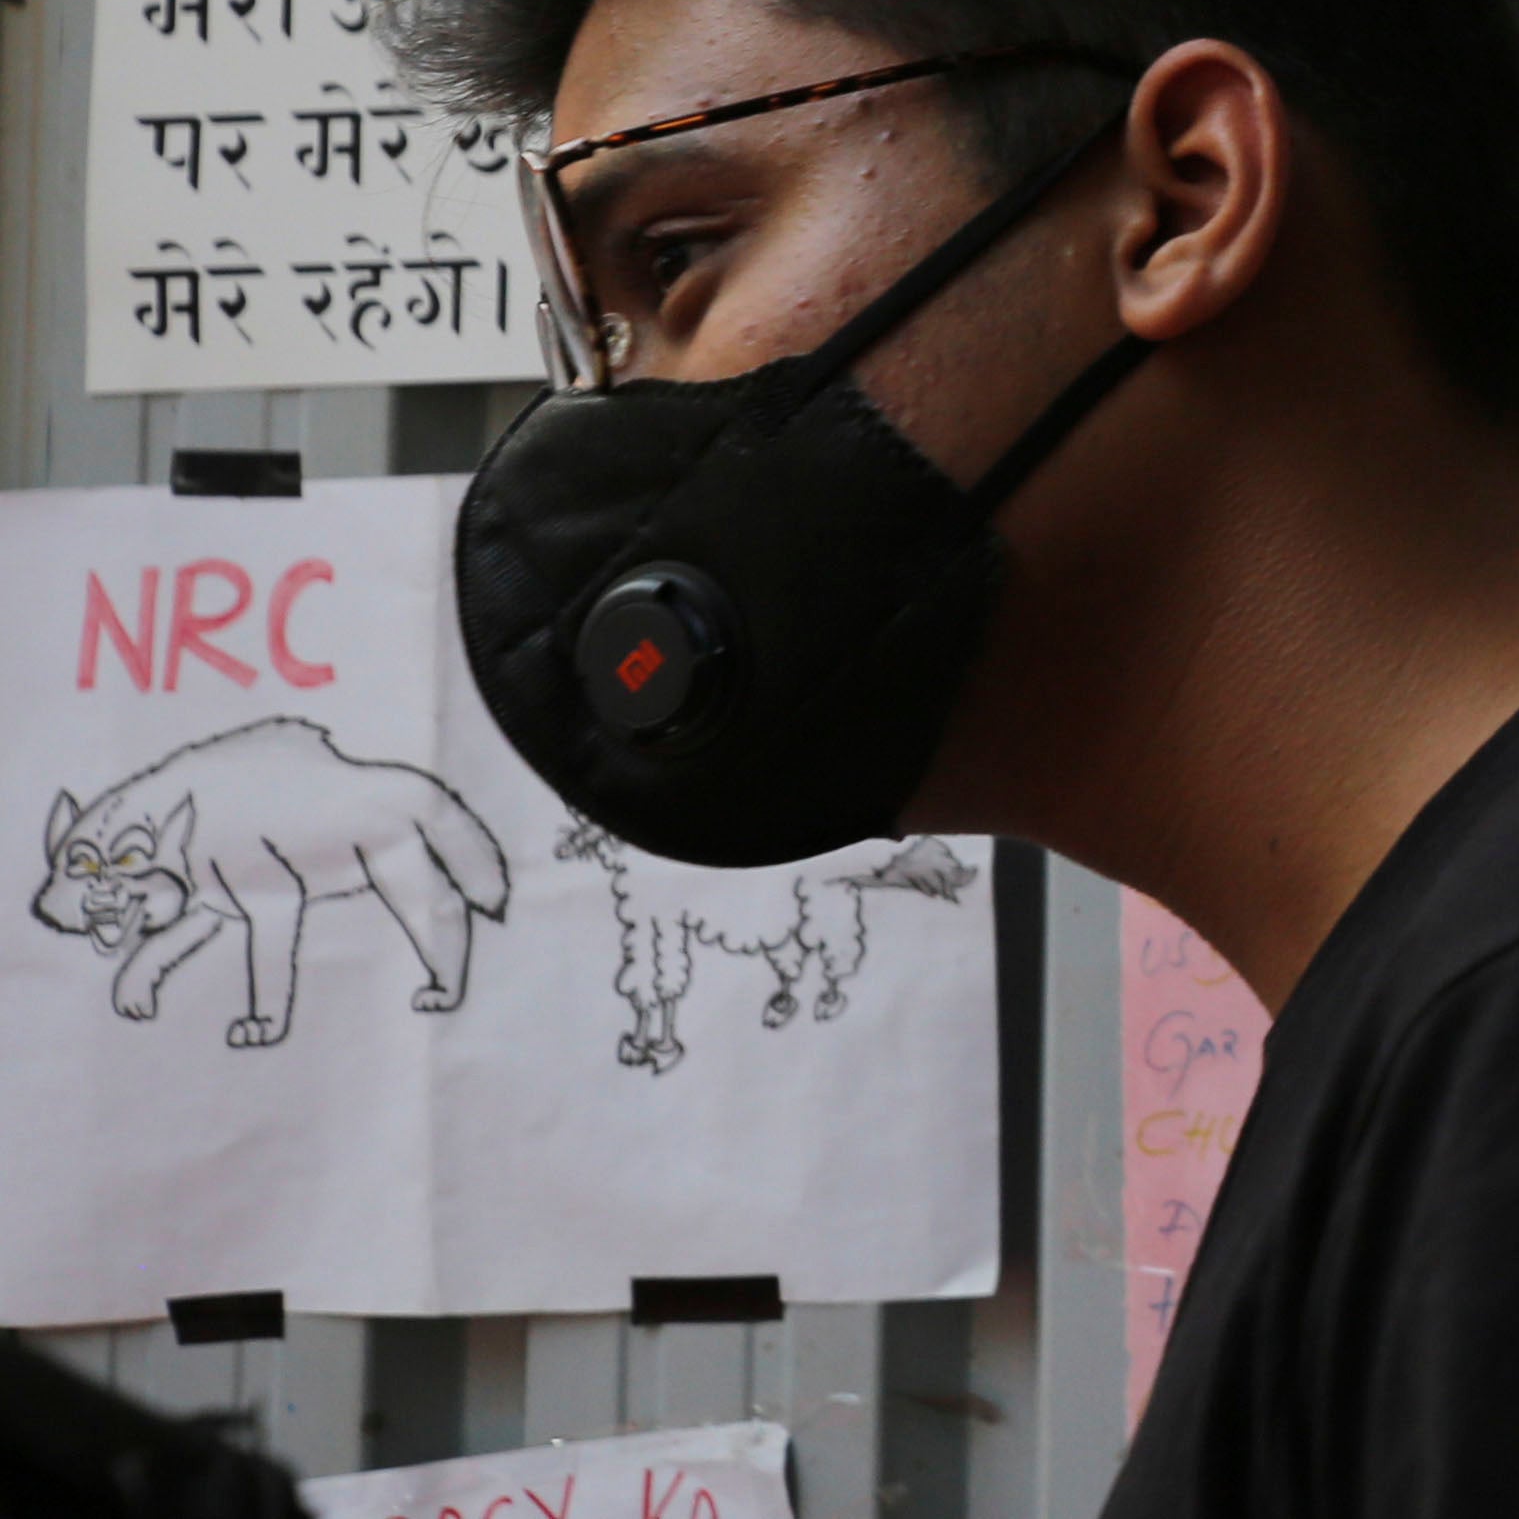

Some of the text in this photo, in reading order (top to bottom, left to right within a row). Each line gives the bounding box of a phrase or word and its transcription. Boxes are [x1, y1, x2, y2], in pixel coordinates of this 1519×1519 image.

[135, 112, 265, 192] पर
[292, 81, 425, 186] मेरे
[127, 237, 265, 347] मेरे
[77, 557, 336, 695] NRC
